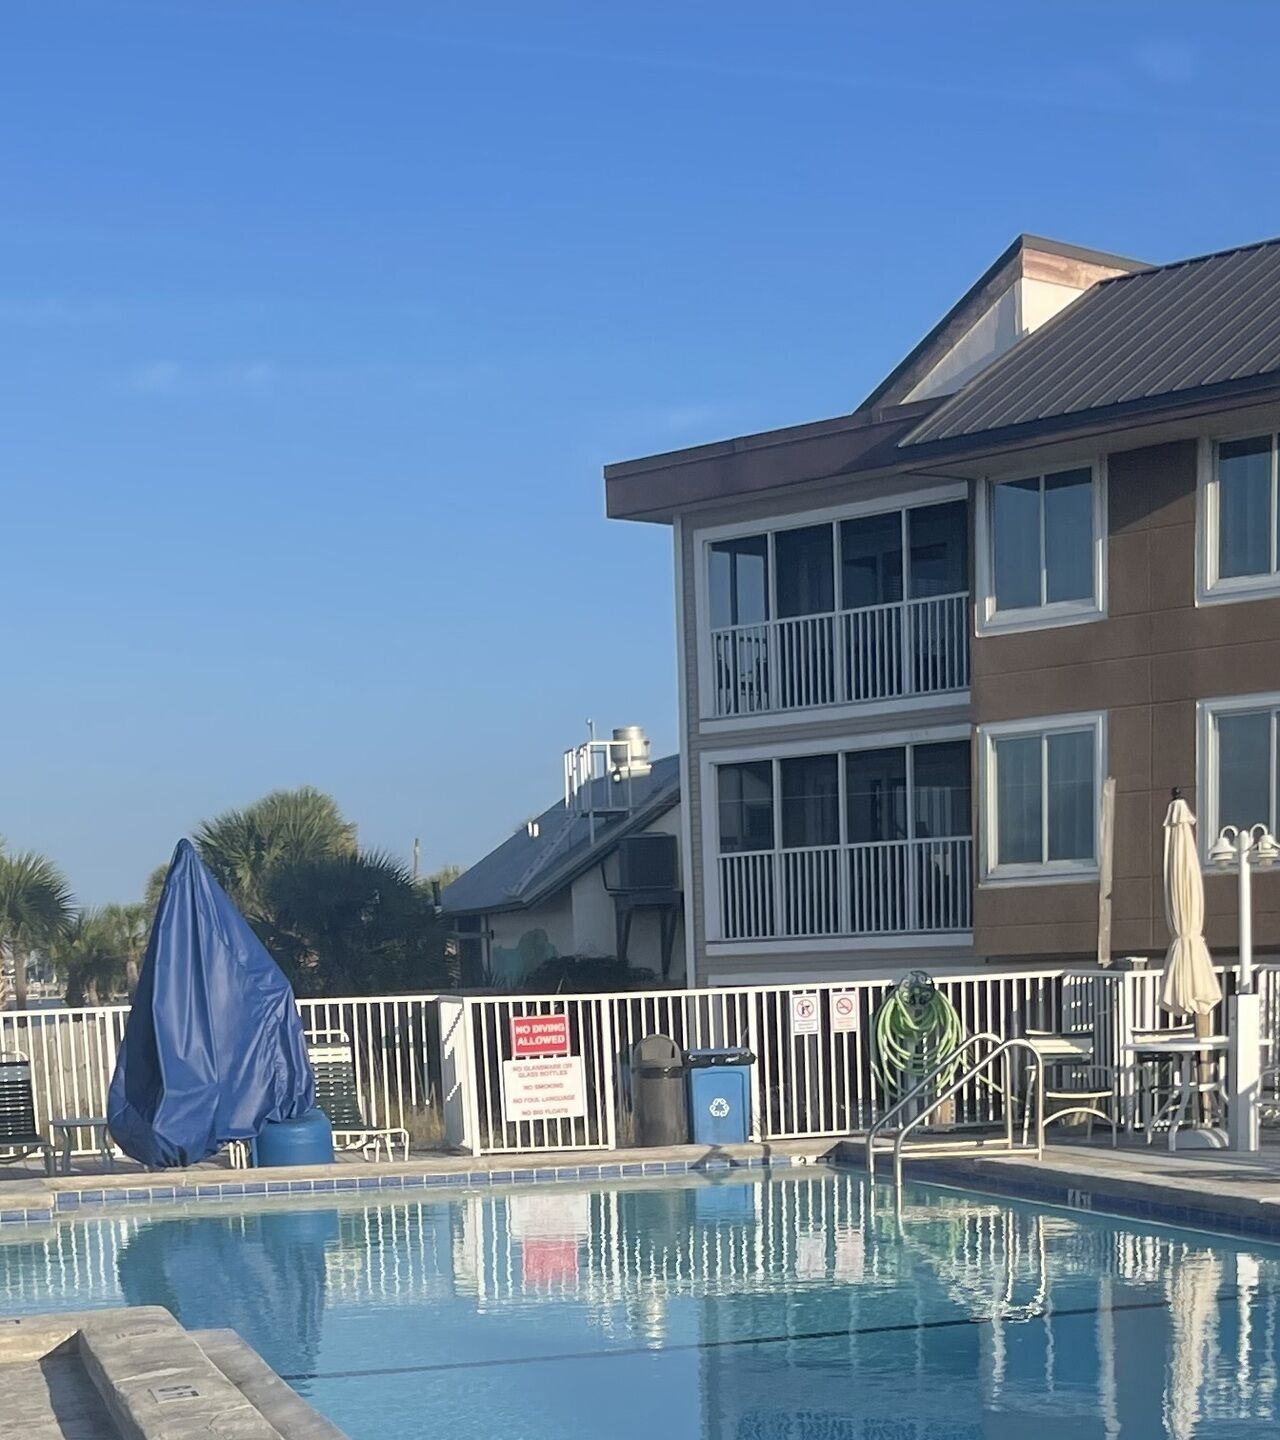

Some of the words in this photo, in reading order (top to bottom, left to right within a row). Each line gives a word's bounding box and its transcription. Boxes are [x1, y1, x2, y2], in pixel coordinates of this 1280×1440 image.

[515, 1025, 530, 1034] NO
[532, 1023, 565, 1033] DIVING
[517, 1035, 565, 1046] ALLOWED
